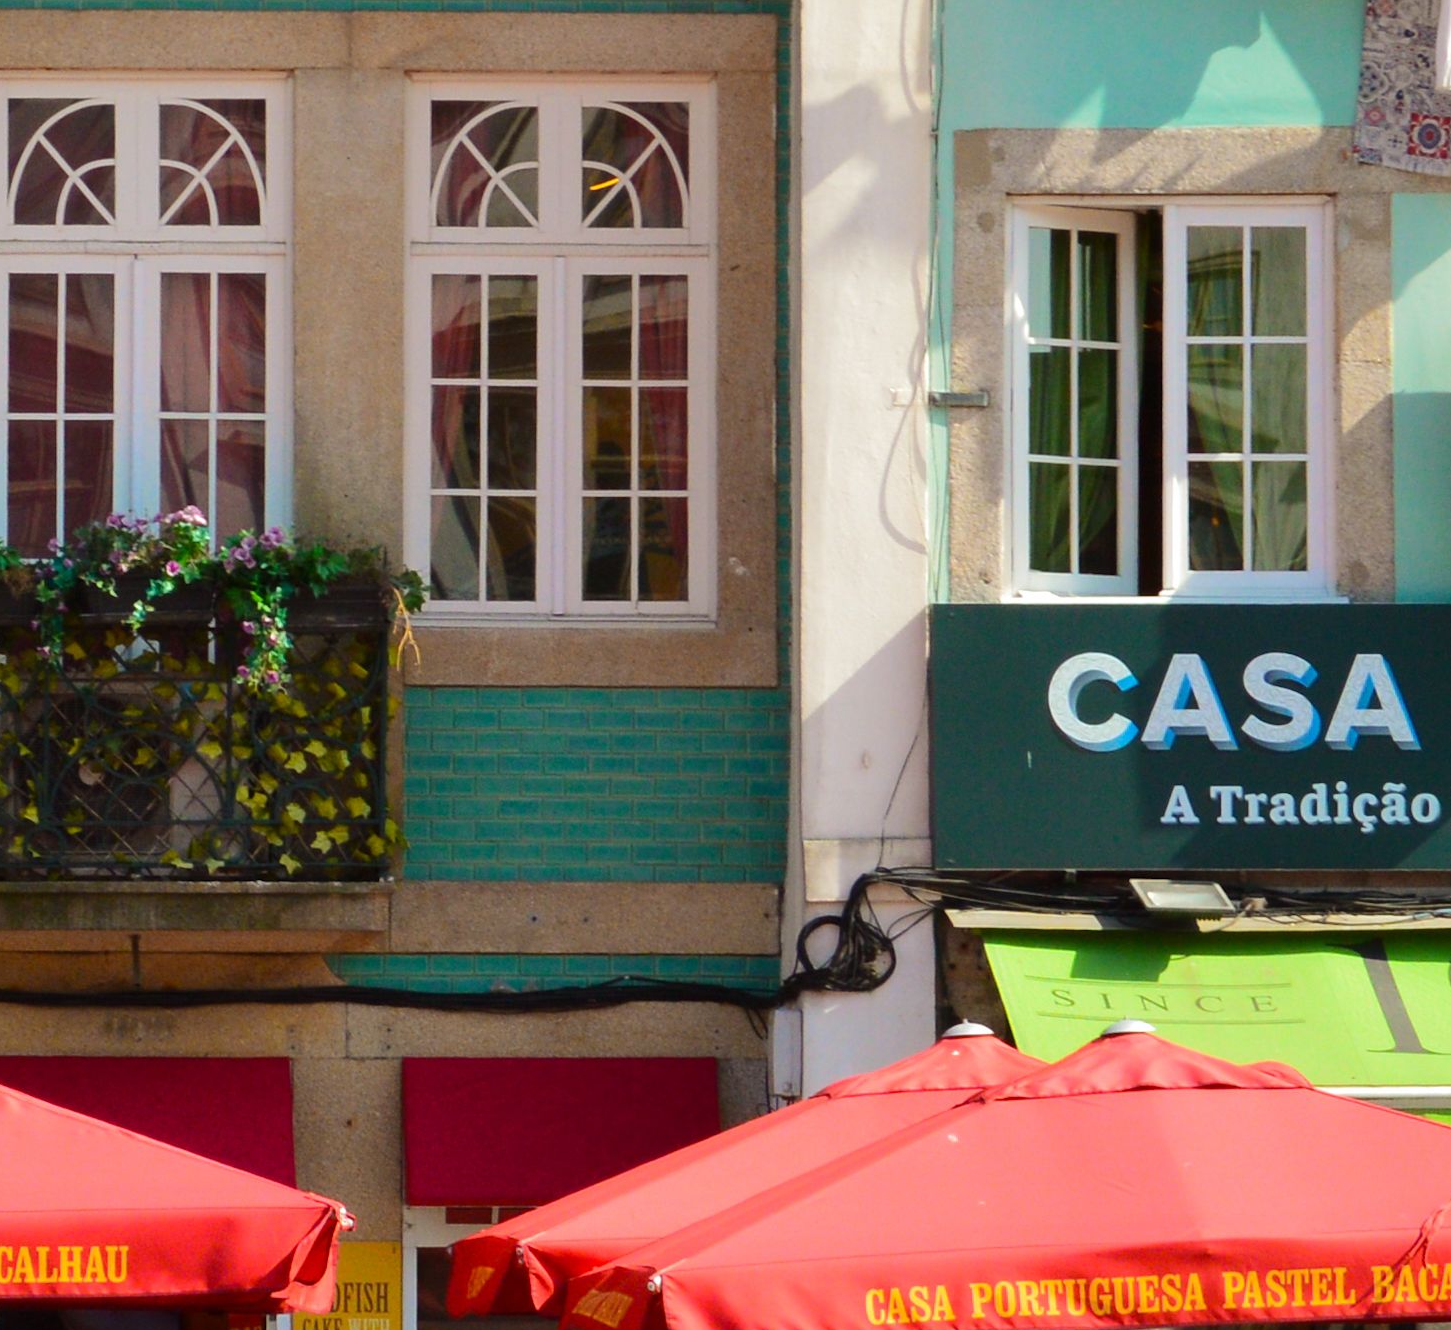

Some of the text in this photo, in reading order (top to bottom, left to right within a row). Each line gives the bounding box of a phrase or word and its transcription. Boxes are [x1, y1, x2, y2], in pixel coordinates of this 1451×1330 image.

[1046, 652, 1423, 753] CASA
[1161, 786, 1199, 824] A
[1210, 781, 1441, 834] Tradição
[1051, 988, 1277, 1015] SINCE
[331, 1282, 389, 1313] DFISH
[865, 1287, 956, 1325] CASA
[970, 1272, 1207, 1318] PORTUGUESA
[1222, 1267, 1356, 1309] PASTEL
